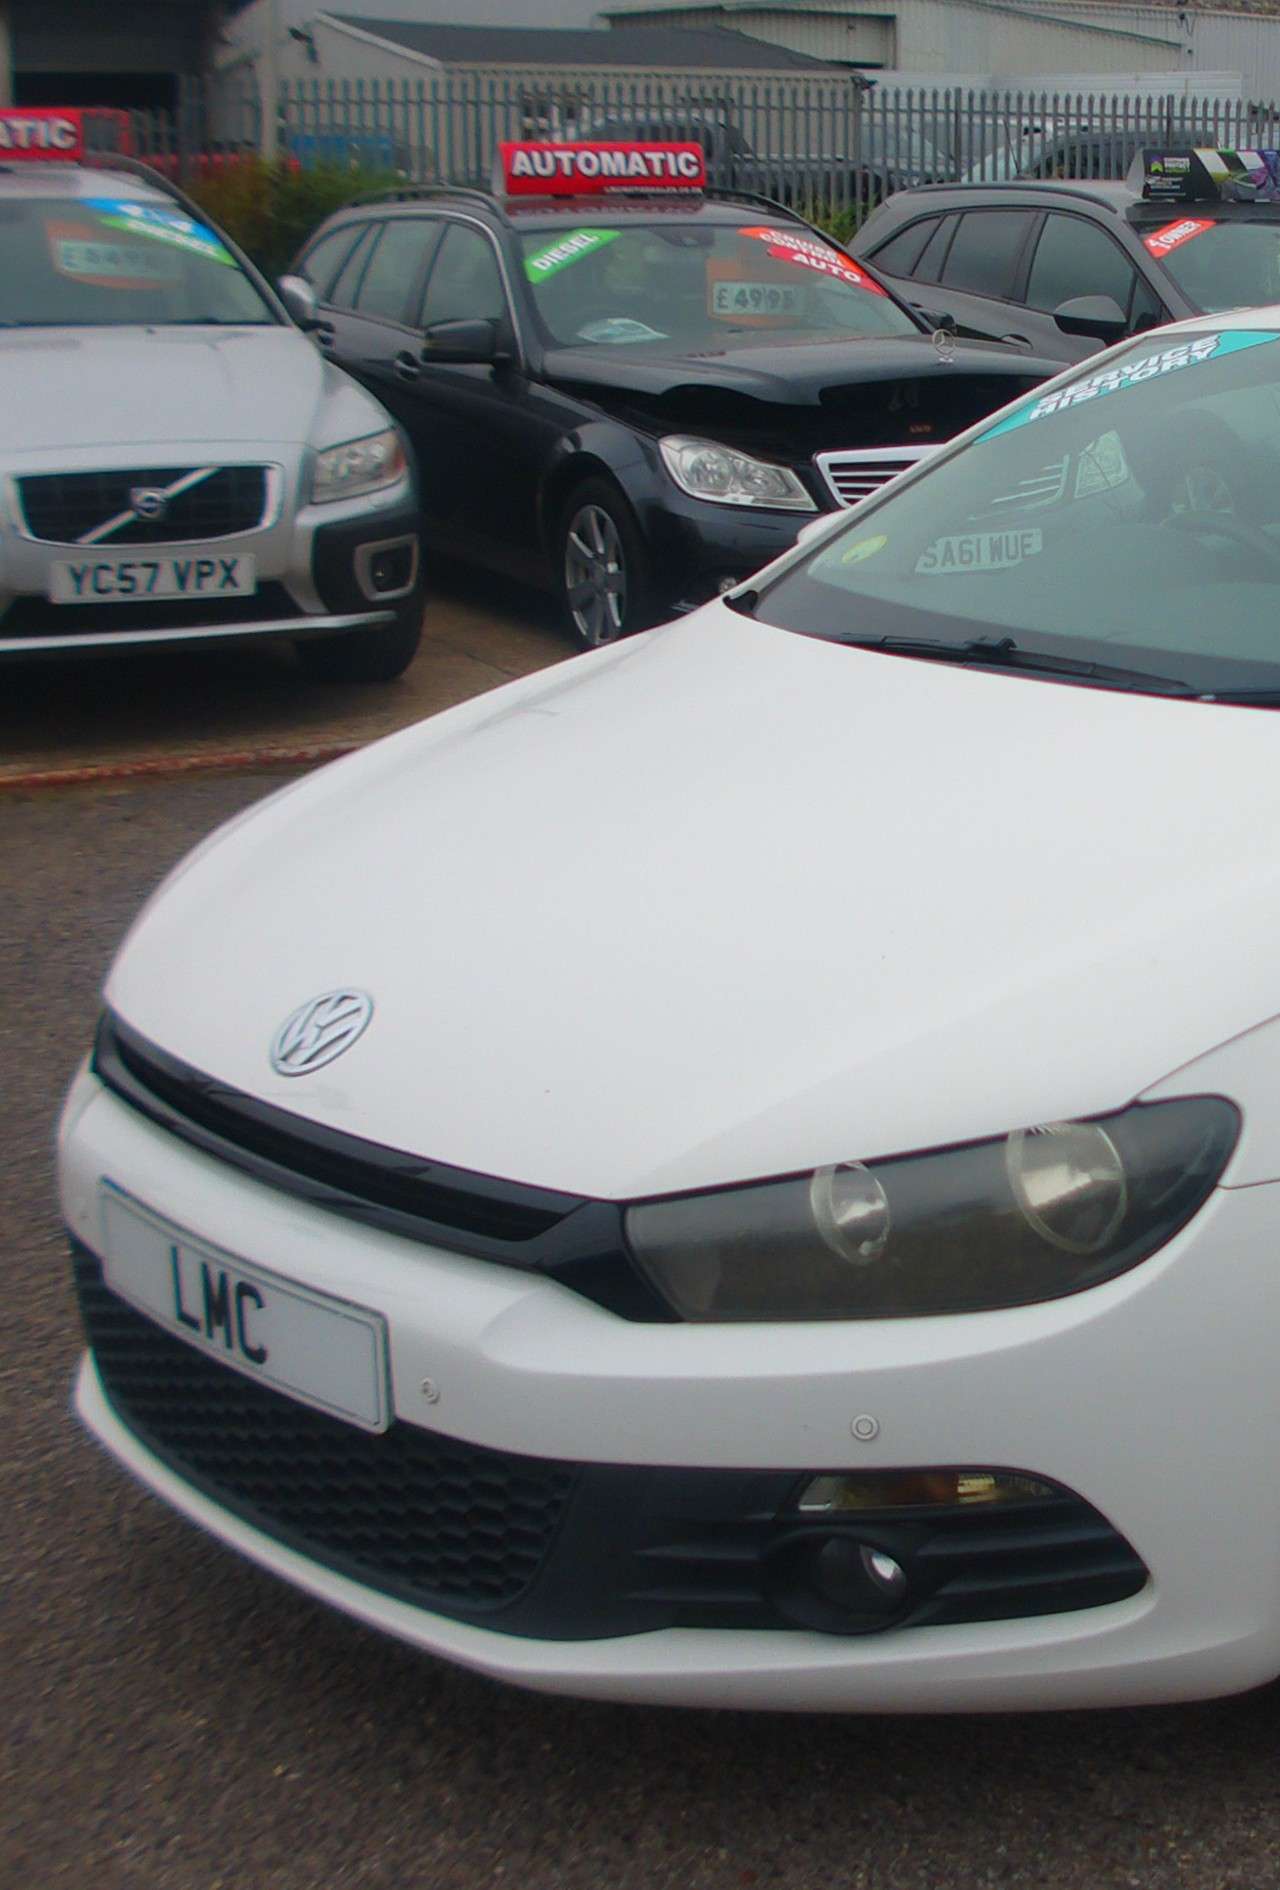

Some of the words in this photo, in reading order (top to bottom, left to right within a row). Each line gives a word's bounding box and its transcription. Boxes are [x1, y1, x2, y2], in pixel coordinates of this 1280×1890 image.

[512, 150, 700, 178] AUTOMATIC
[532, 233, 600, 271] DIESEL
[792, 254, 861, 283] AUTO
[1029, 348, 1215, 420] HISTORY
[1038, 334, 1221, 403] SERVICE
[923, 538, 982, 568] SA61
[68, 563, 160, 594] YC57
[173, 558, 239, 591] VPX
[171, 1245, 268, 1364] LMC
